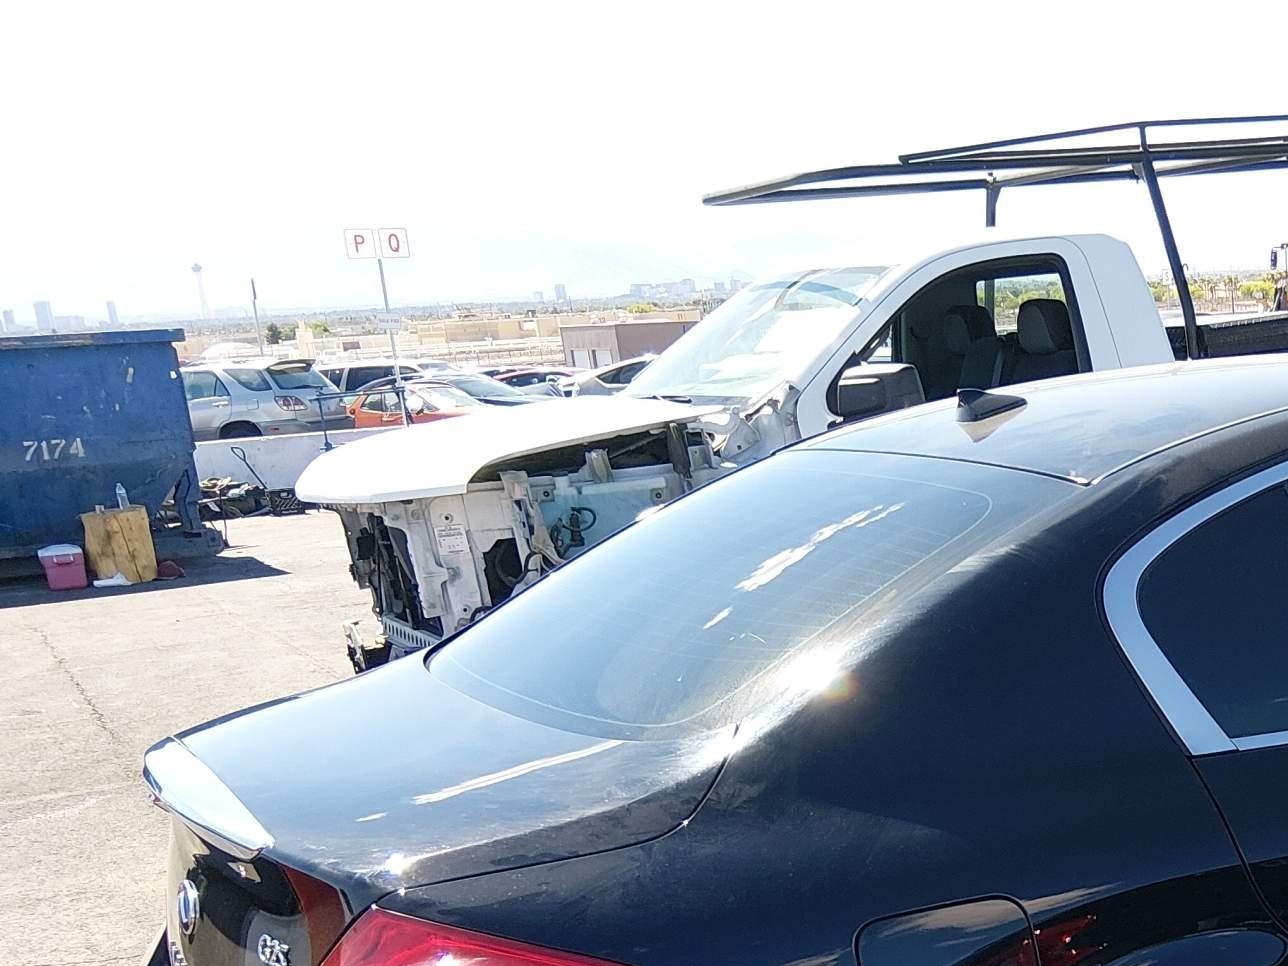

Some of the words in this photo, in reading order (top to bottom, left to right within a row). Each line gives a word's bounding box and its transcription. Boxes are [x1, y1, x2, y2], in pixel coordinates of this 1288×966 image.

[354, 234, 365, 253] P
[388, 233, 400, 253] Q
[23, 438, 86, 461] 7174
